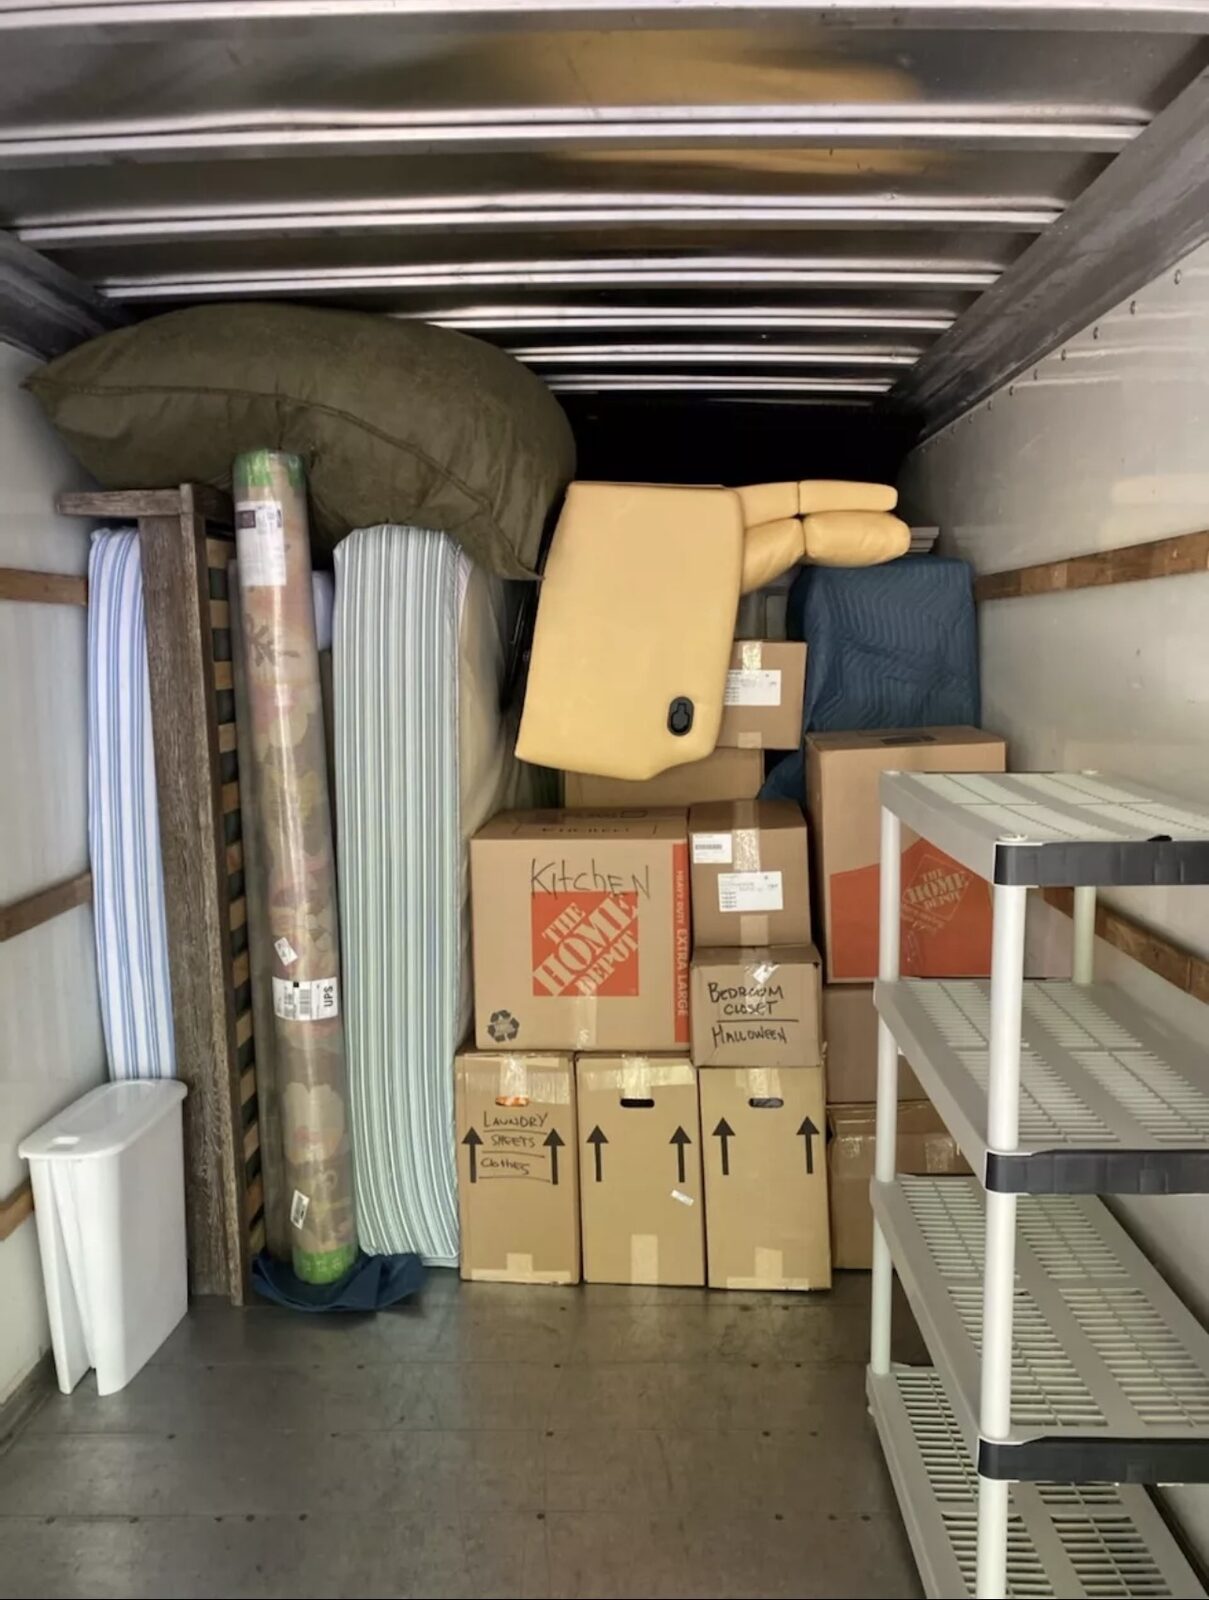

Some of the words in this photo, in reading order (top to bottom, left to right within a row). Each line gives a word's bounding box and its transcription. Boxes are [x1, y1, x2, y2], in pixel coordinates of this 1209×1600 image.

[908, 871, 969, 904] HOME
[541, 901, 586, 945] THE
[532, 892, 639, 997] HOME
[676, 928, 689, 970] EXTRA
[574, 930, 639, 997] DEPOT
[323, 985, 334, 1008] UPS
[677, 974, 689, 1016] LARGE
[707, 982, 785, 1003] BEDROOM
[723, 1000, 779, 1016] CLOSET
[711, 1023, 788, 1049] HALLOWEEN
[483, 1110, 549, 1128] LAUNDRY
[491, 1133, 536, 1149] SHEETS
